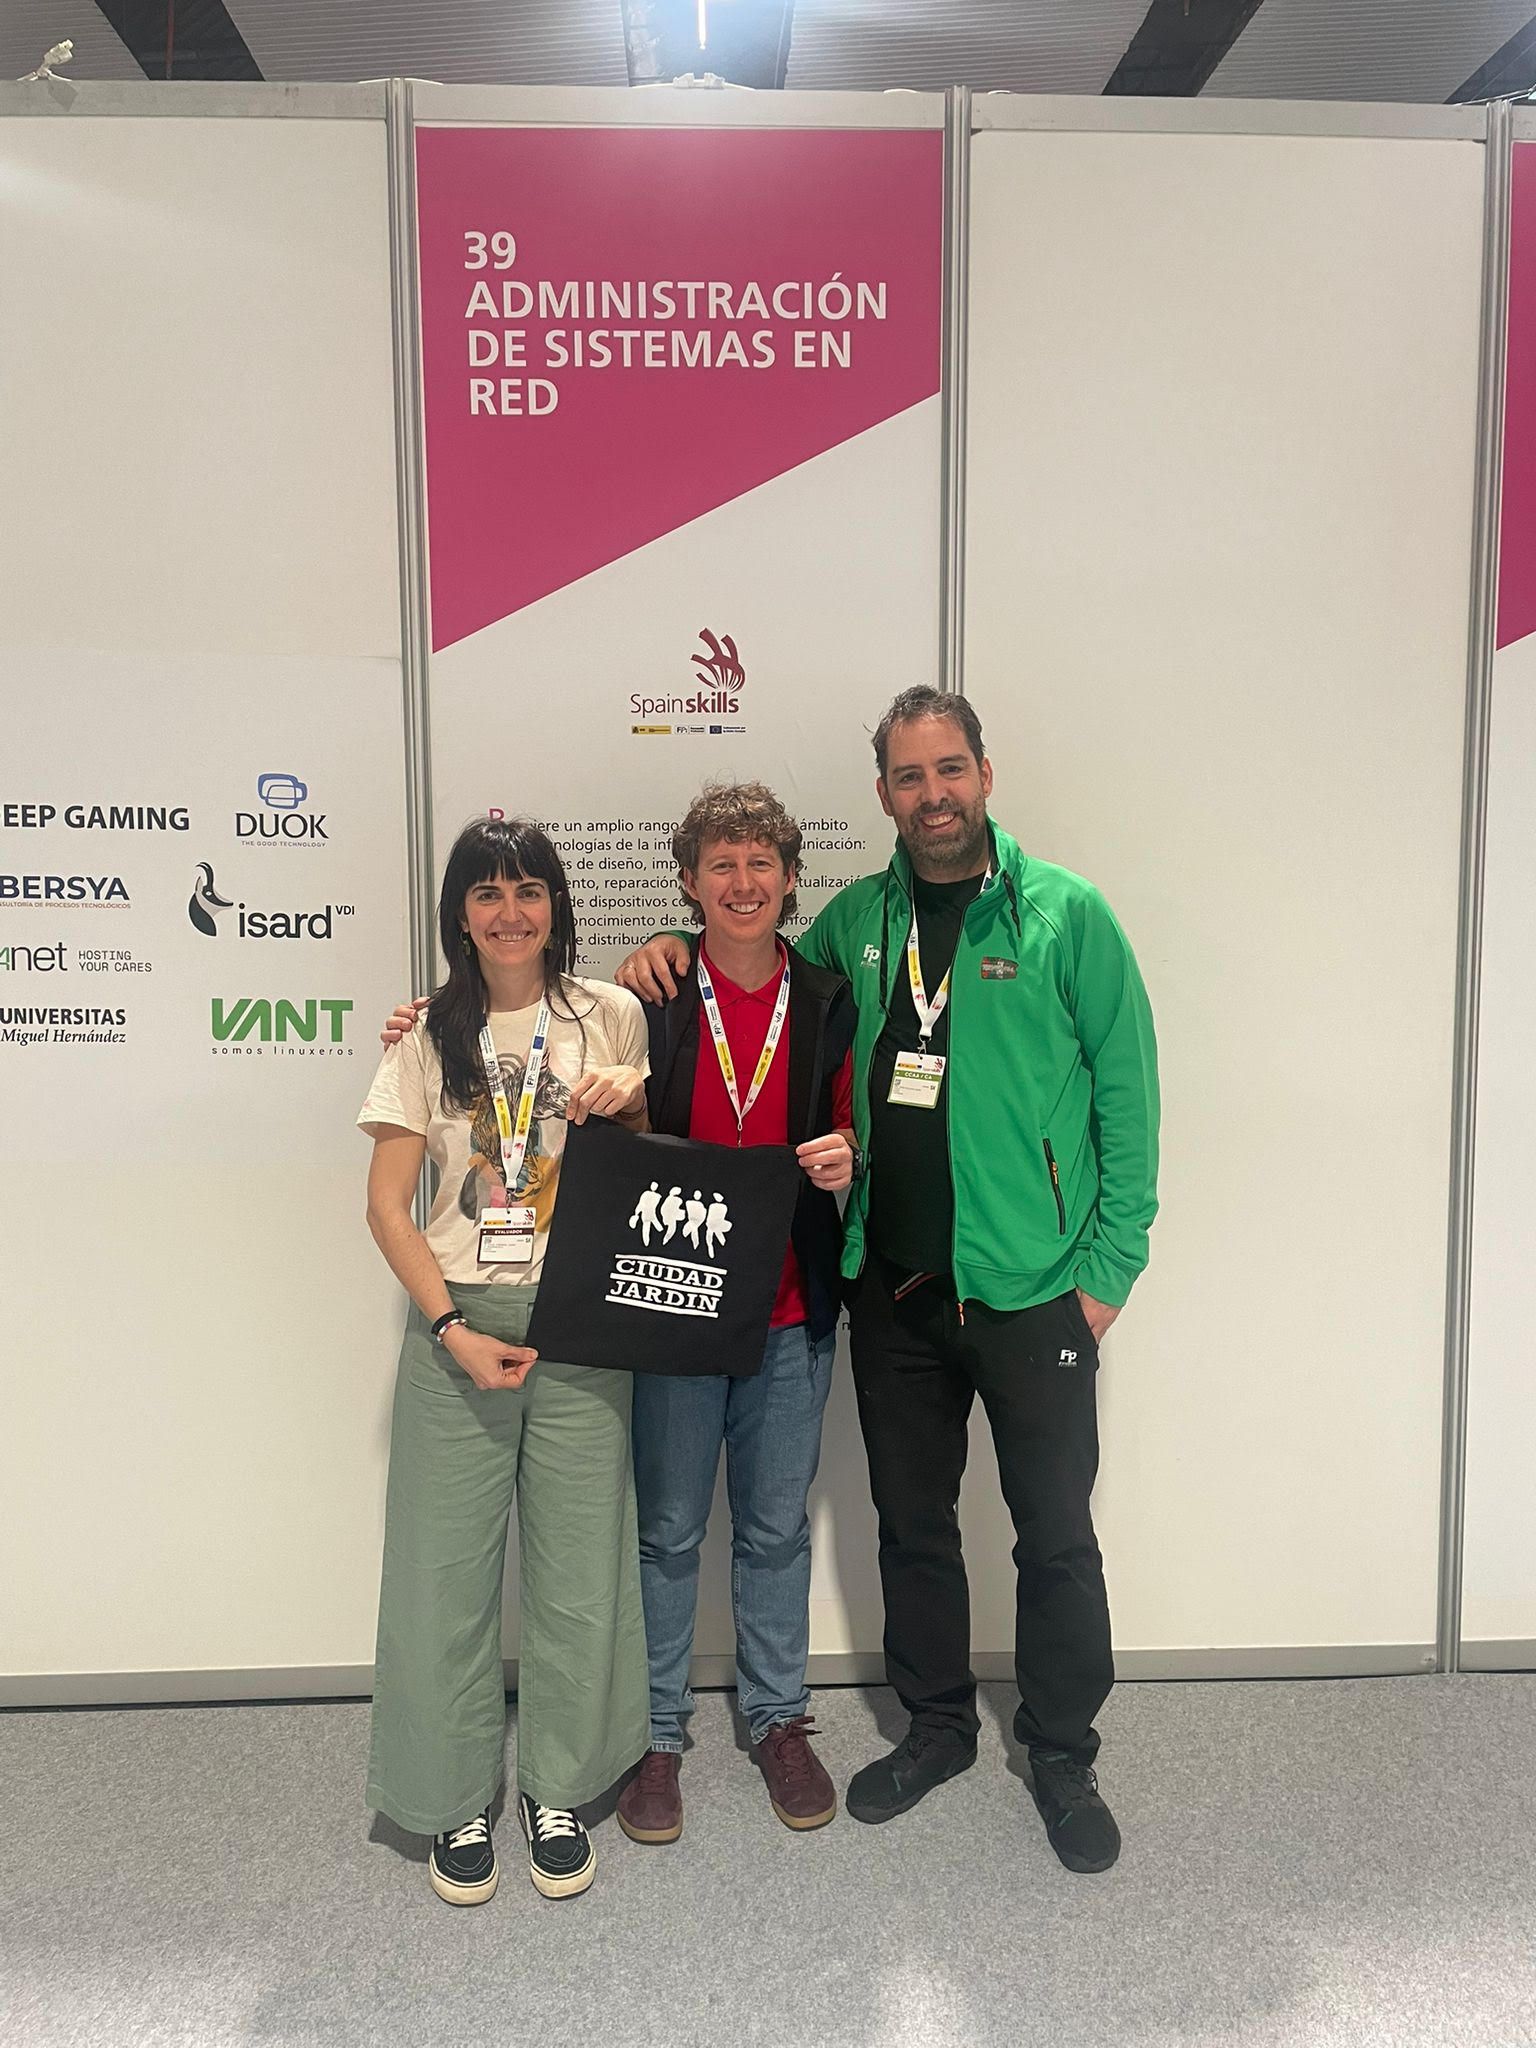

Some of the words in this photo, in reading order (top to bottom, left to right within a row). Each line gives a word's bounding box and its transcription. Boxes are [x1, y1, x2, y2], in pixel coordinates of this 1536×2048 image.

[464, 231, 517, 270] 39
[464, 272, 888, 320] ADMINISTRACIÓN
[468, 330, 527, 367] DE
[545, 329, 776, 369] SISTEMAS
[794, 331, 851, 368] EN
[470, 378, 559, 415] RED
[630, 691, 740, 718] Spainskills
[3, 804, 56, 828] EEP
[64, 805, 190, 831] GAMING
[235, 813, 330, 839] DUOK
[564, 822, 582, 832] un
[586, 818, 634, 835] amplio
[638, 821, 679, 835] rango
[799, 818, 848, 831] ámbito
[553, 838, 612, 854] nologías
[616, 838, 633, 851] de
[637, 838, 650, 851] la
[576, 857, 594, 870] de
[598, 856, 647, 871] diseño,
[0, 875, 130, 901] BERSYA
[604, 875, 681, 892] reparación,
[588, 895, 668, 910] dispositivos
[238, 902, 332, 939] isard
[335, 905, 355, 915] VDI
[573, 914, 656, 927] onocimiento
[660, 914, 677, 926] de
[78, 950, 132, 961] HOSTING
[575, 953, 601, 965] tc...
[78, 961, 109, 972] YOUR
[114, 962, 153, 973] CARES
[0, 1007, 126, 1026] UNIVERSITAS
[211, 998, 354, 1043] VANT
[1, 1028, 49, 1047] Miguel
[52, 1029, 126, 1043] Hernández
[211, 1046, 263, 1055] somos
[273, 1046, 354, 1056] linuxeros
[615, 1259, 724, 1290] CIUDAD
[609, 1280, 721, 1312] JARDIN
[1060, 1349, 1078, 1363] Fp
